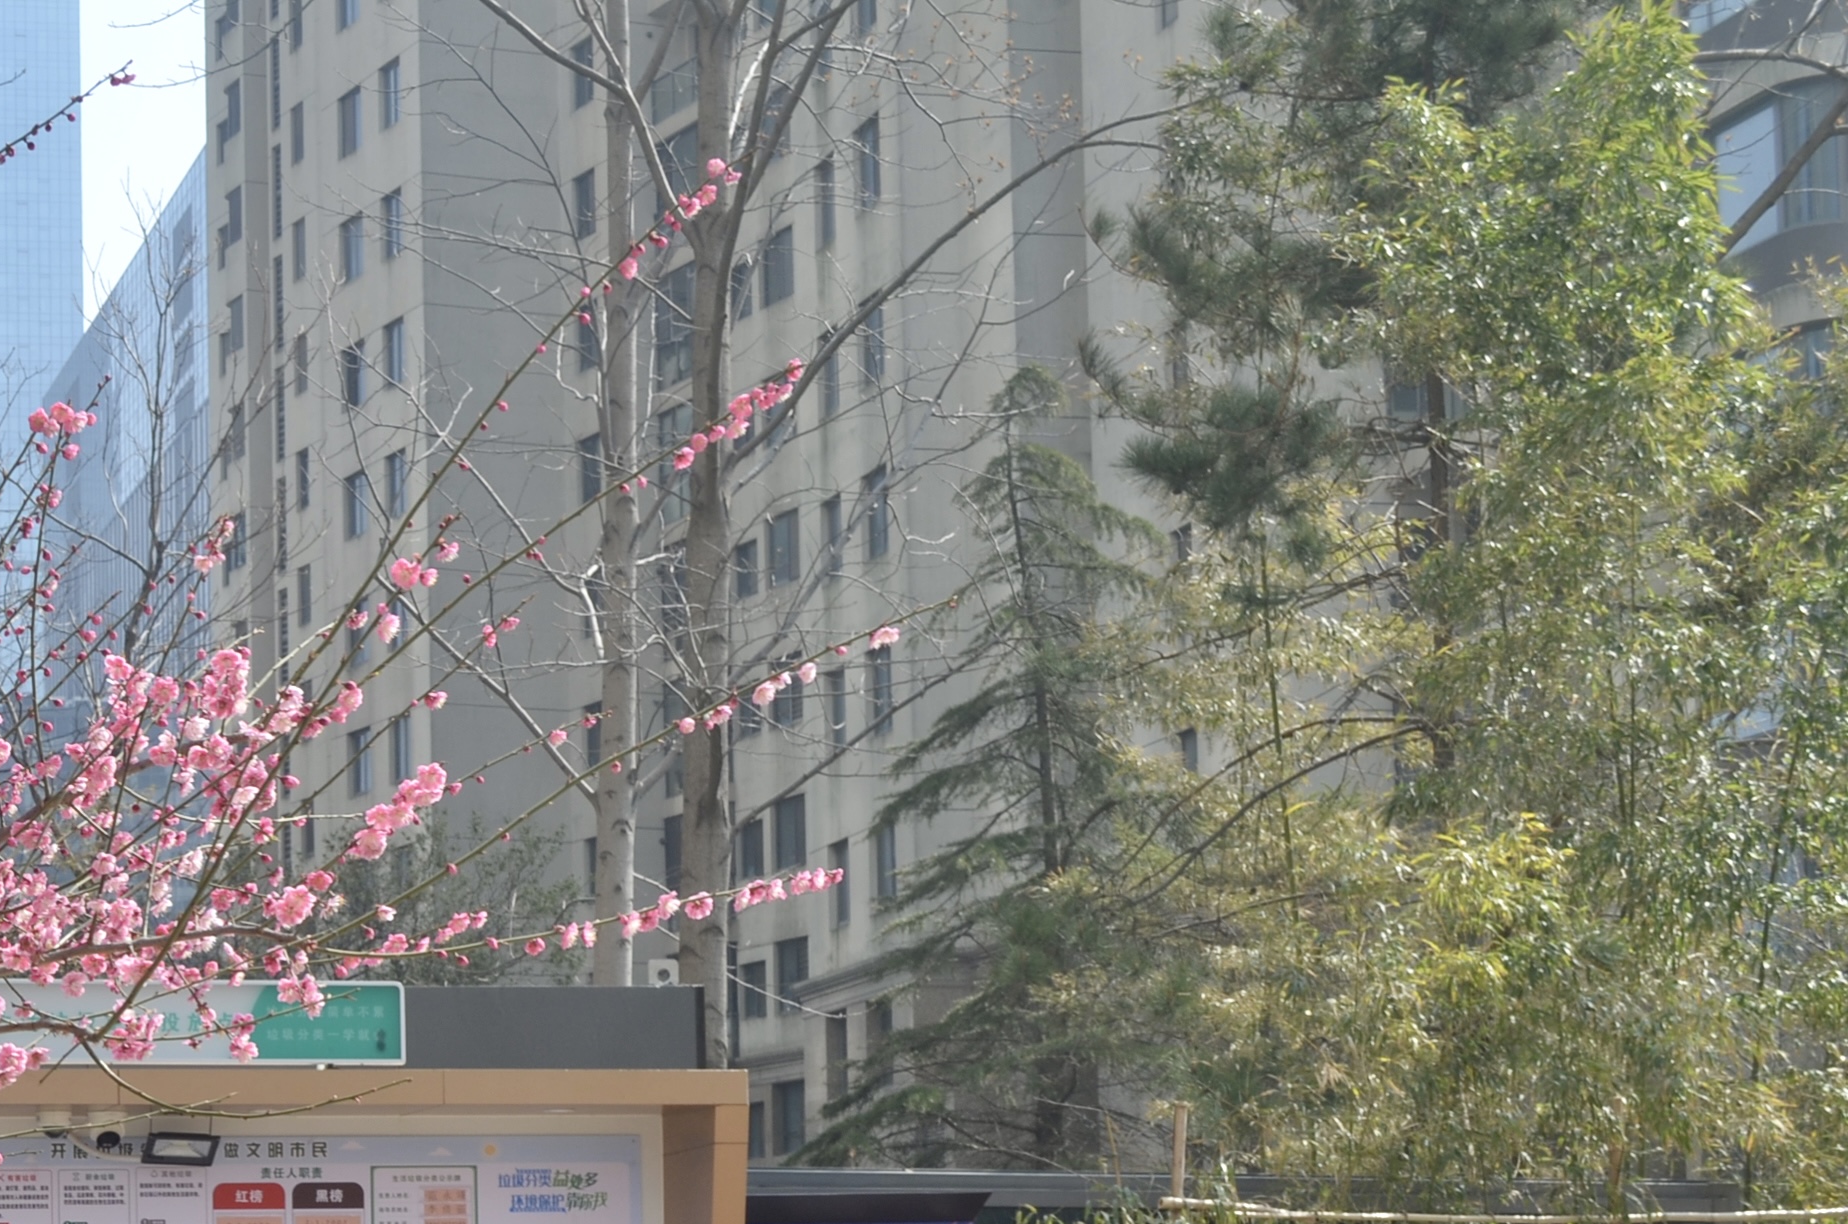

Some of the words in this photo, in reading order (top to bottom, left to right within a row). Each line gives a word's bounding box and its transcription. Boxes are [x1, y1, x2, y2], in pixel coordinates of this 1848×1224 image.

[224, 1142, 327, 1158] 做文明市民
[261, 1167, 323, 1179] 责任人职责
[498, 1169, 599, 1189] 垃圾分类益处多
[235, 1189, 264, 1203] 红榜
[316, 1189, 343, 1203] 黑榜
[510, 1192, 608, 1213] 环境保护靠你我
